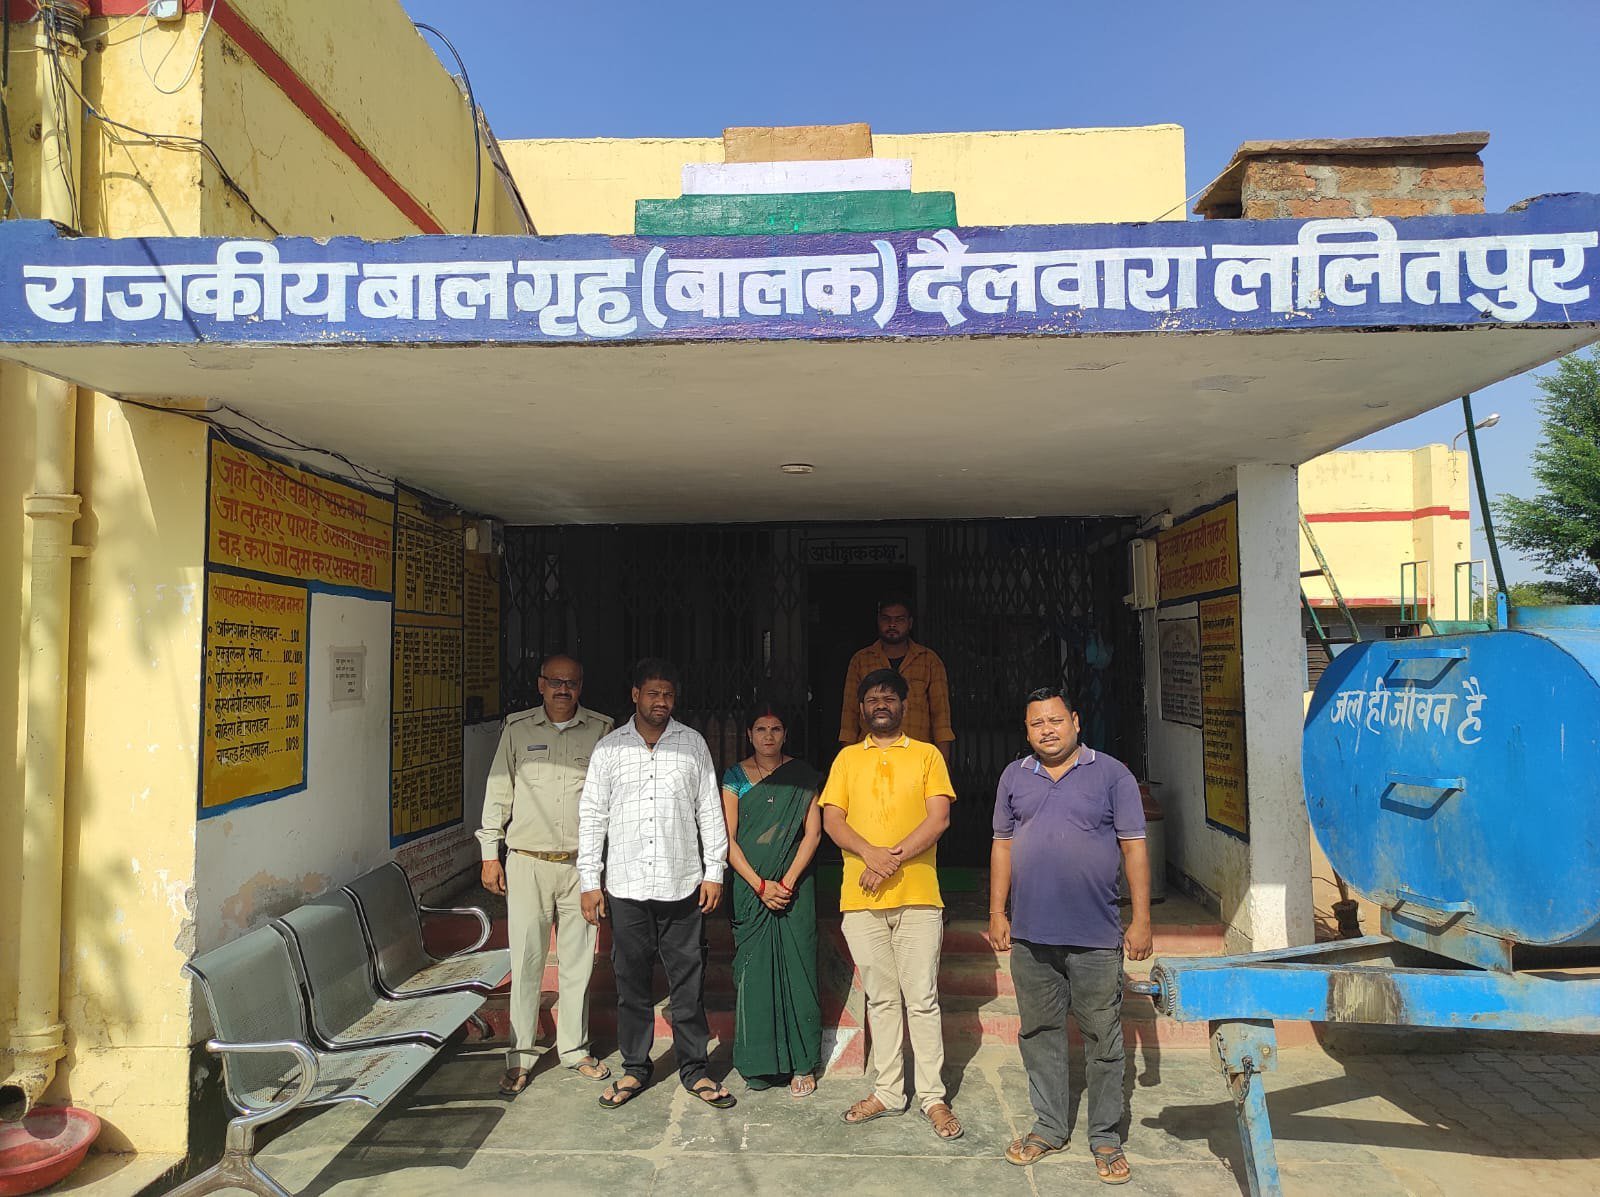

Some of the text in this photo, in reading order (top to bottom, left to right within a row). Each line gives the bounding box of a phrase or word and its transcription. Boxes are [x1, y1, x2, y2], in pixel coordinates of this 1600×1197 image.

[23, 240, 358, 323] राजकीय
[642, 239, 900, 331] (बालक)
[907, 228, 1206, 328] दैलवारा
[1211, 217, 1599, 323] ललितपुर
[286, 512, 309, 544] पास
[218, 529, 245, 563] वह
[244, 531, 271, 567] करो
[271, 535, 289, 568] जो
[289, 545, 311, 575] तुम
[311, 551, 332, 578] कर
[332, 551, 359, 583] सकते
[249, 642, 262, 663] सेवा
[215, 667, 234, 692] पुलिस
[1330, 676, 1488, 745] जल ही जीवन है
